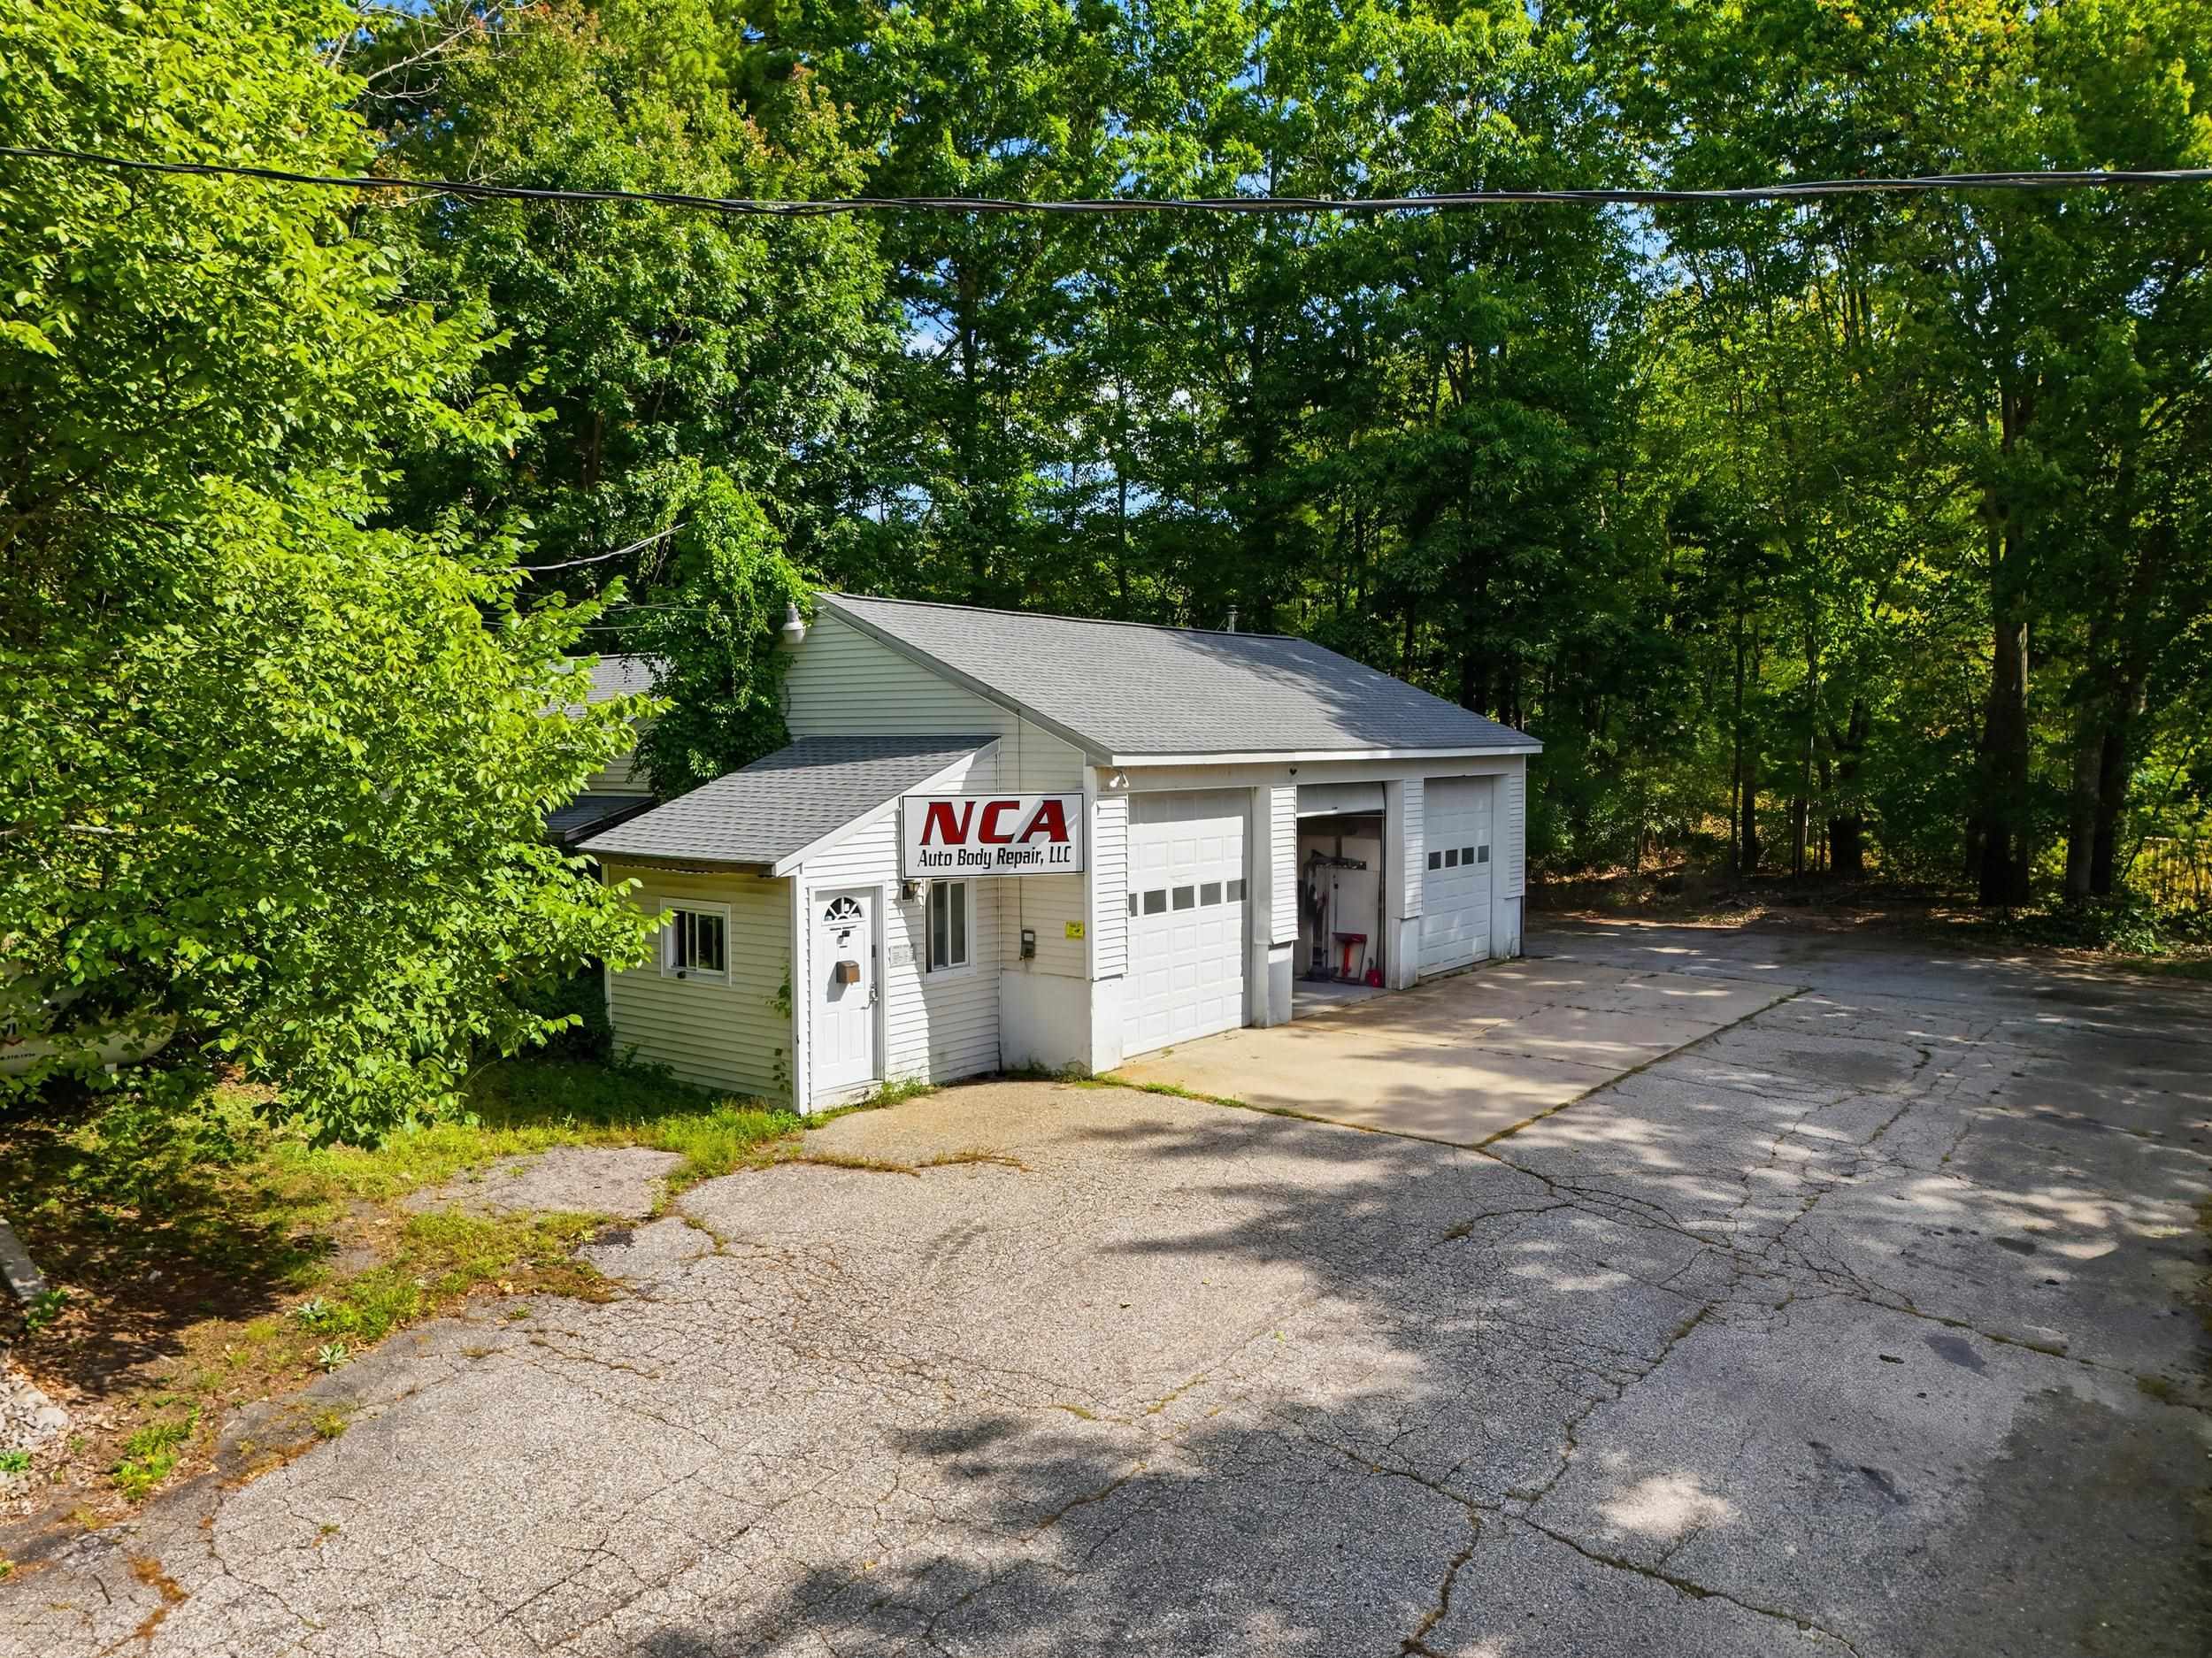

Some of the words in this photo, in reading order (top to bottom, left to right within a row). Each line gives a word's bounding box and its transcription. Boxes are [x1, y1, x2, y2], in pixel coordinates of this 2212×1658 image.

[918, 800, 1070, 846] NCA
[918, 849, 952, 867] Auto
[957, 848, 991, 869] Body
[996, 847, 1044, 868] Repair,
[1049, 846, 1071, 864] LLC
